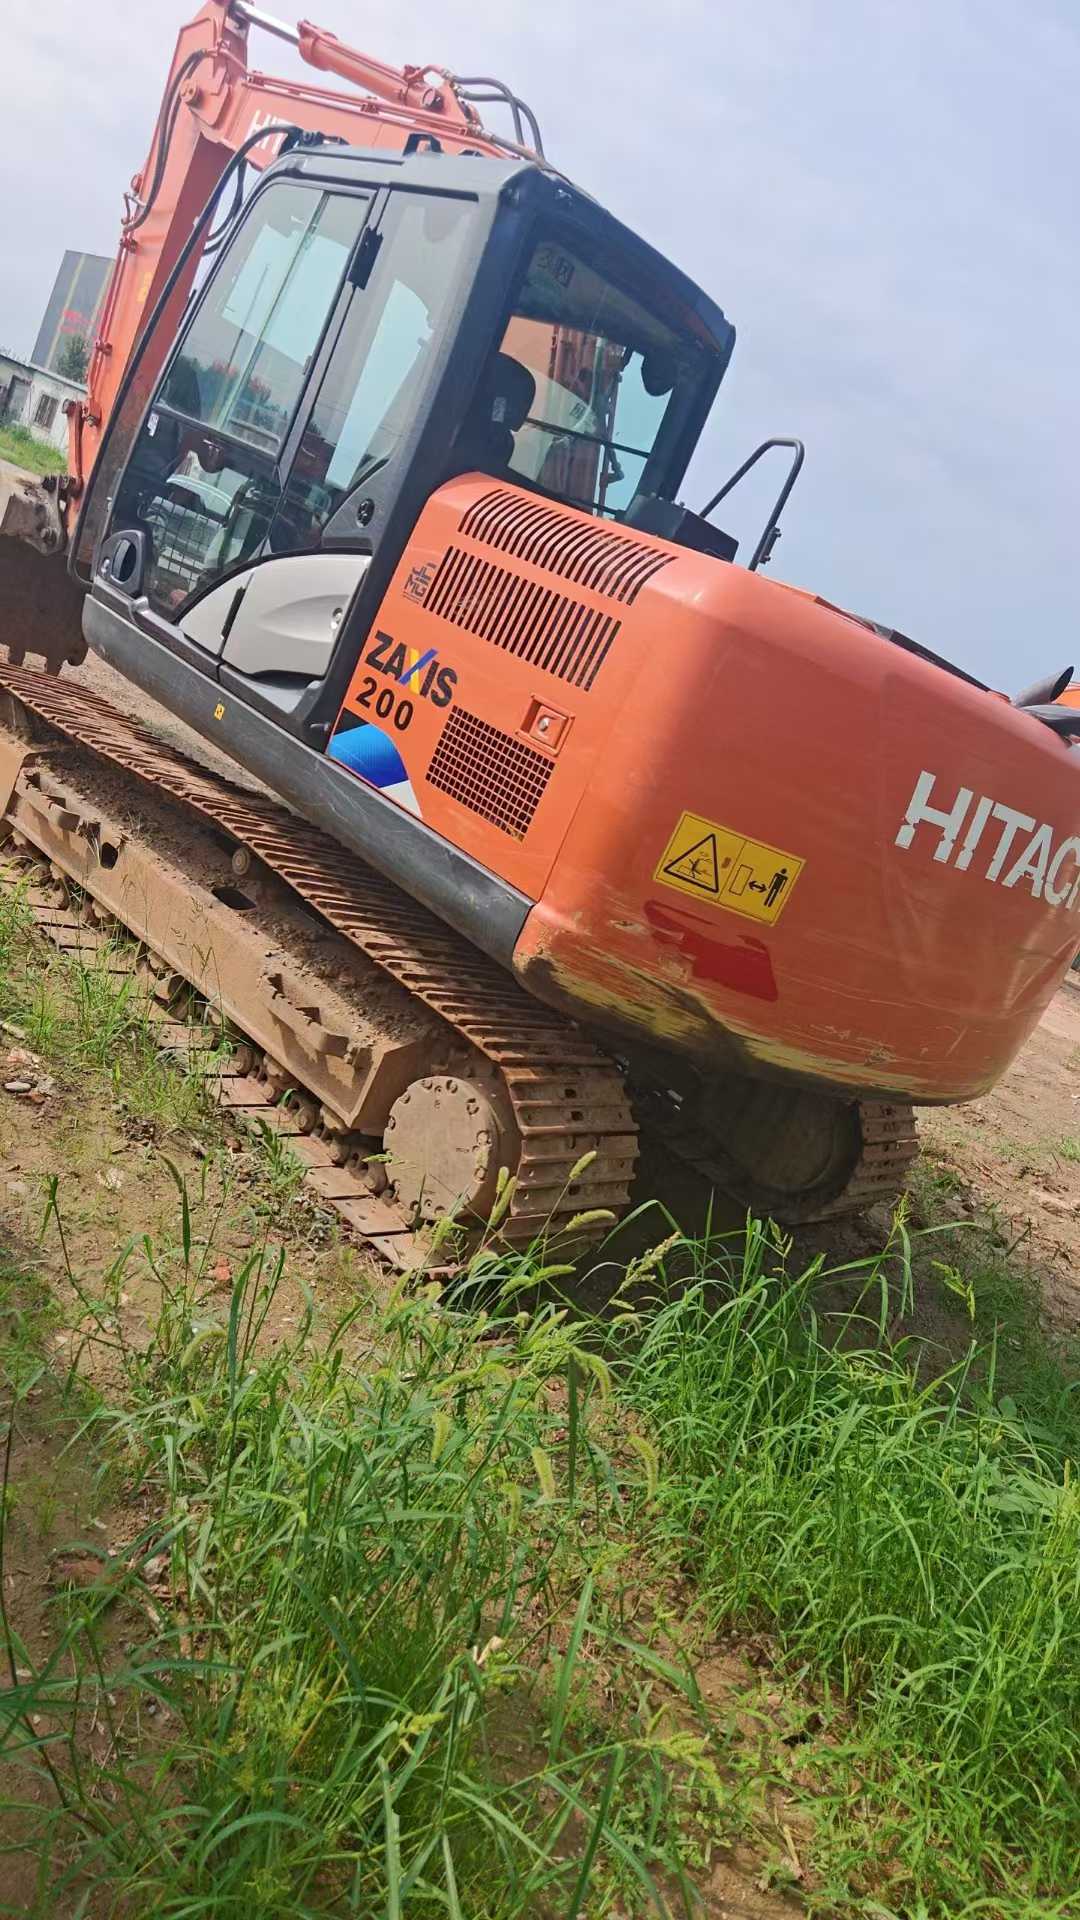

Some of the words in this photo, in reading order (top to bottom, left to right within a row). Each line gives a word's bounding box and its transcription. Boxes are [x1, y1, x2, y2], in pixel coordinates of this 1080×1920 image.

[356, 677, 414, 731] 200
[365, 630, 458, 708] ZAXIS
[894, 770, 1080, 913] HITAC
